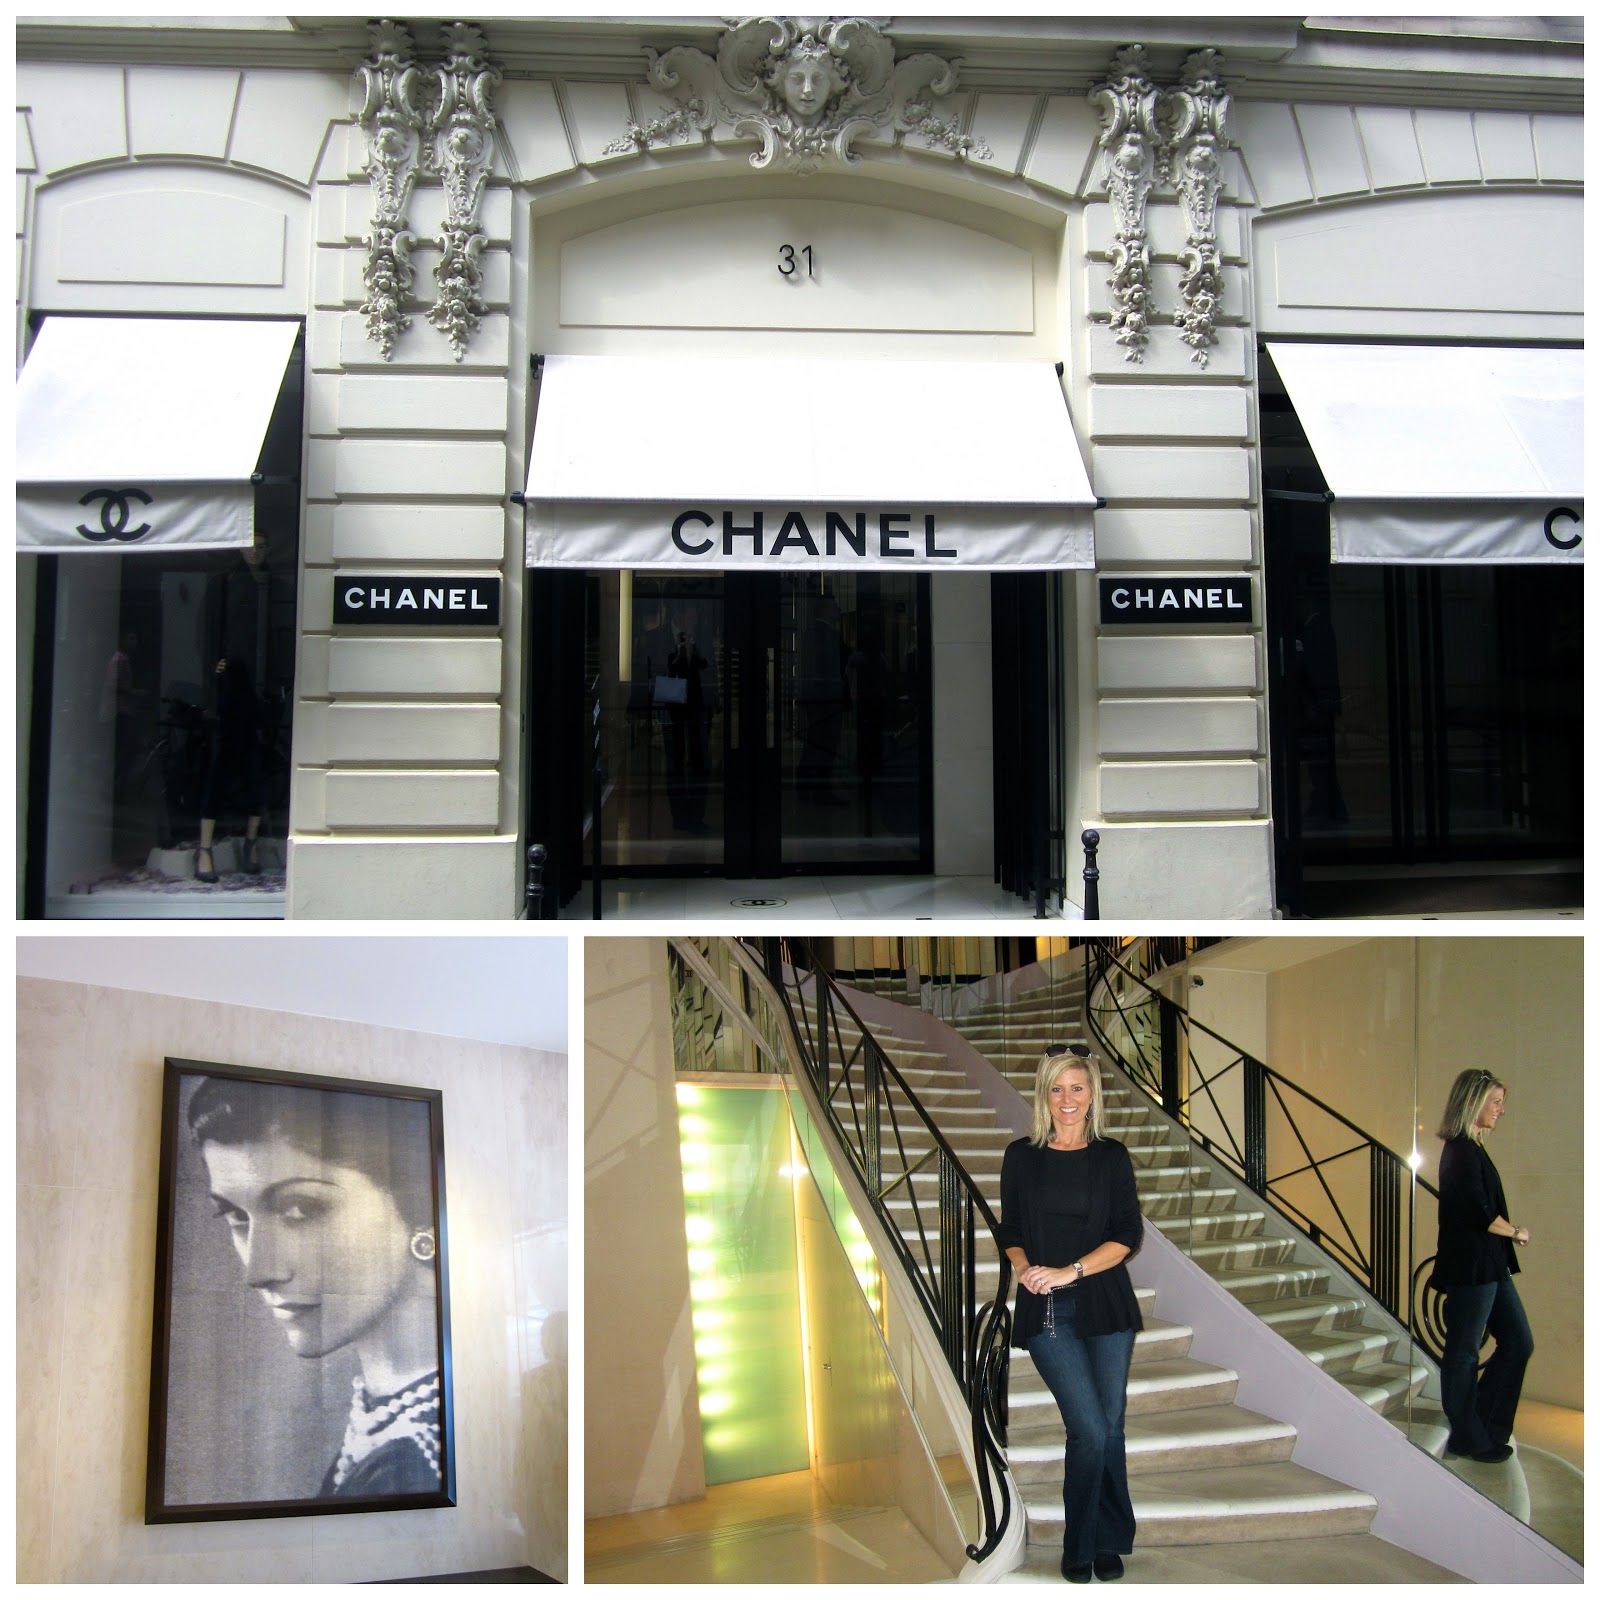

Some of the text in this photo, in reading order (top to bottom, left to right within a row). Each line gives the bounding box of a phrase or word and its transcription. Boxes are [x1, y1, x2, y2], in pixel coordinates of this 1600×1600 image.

[777, 244, 814, 276] 31
[671, 510, 957, 558] CHANEL
[344, 587, 488, 610] CHANEL
[1111, 588, 1243, 609] CHANEL
